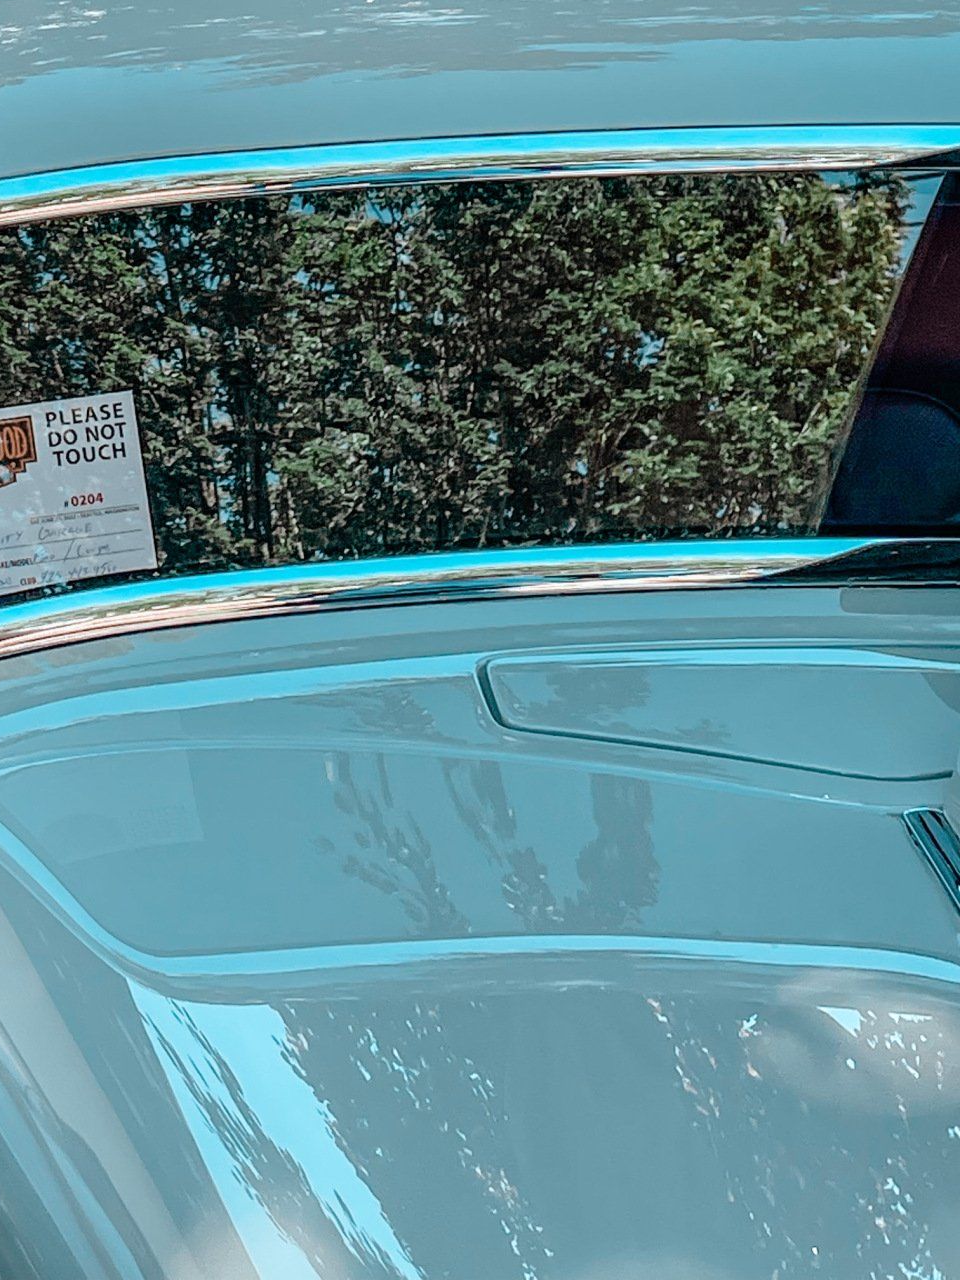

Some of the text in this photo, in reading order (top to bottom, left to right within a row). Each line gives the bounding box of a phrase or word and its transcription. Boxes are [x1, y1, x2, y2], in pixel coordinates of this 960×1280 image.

[45, 401, 124, 428] PLEASE
[48, 421, 127, 448] DO NOT
[52, 442, 127, 467] TOUCH
